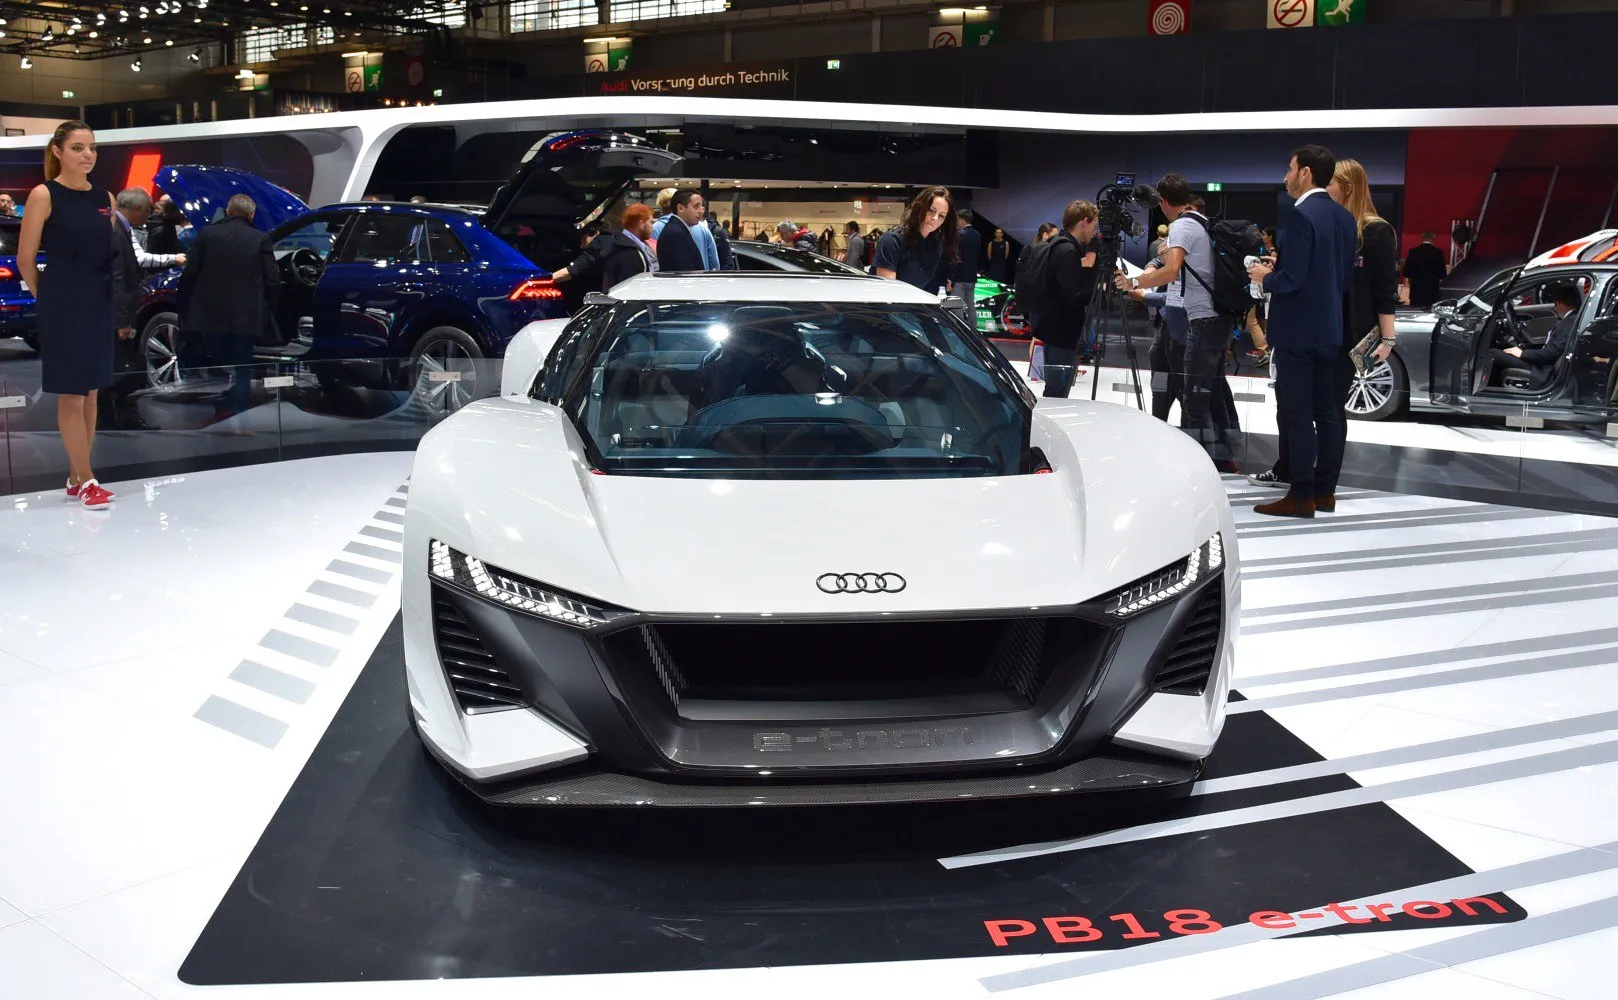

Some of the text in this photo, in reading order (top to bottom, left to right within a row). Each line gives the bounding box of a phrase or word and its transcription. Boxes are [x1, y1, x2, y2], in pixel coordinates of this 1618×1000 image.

[600, 80, 628, 92] Audi
[698, 73, 735, 87] durch
[738, 69, 790, 84] Technik
[753, 727, 973, 751] e-tron
[985, 895, 1508, 947] PB18 e-tron
